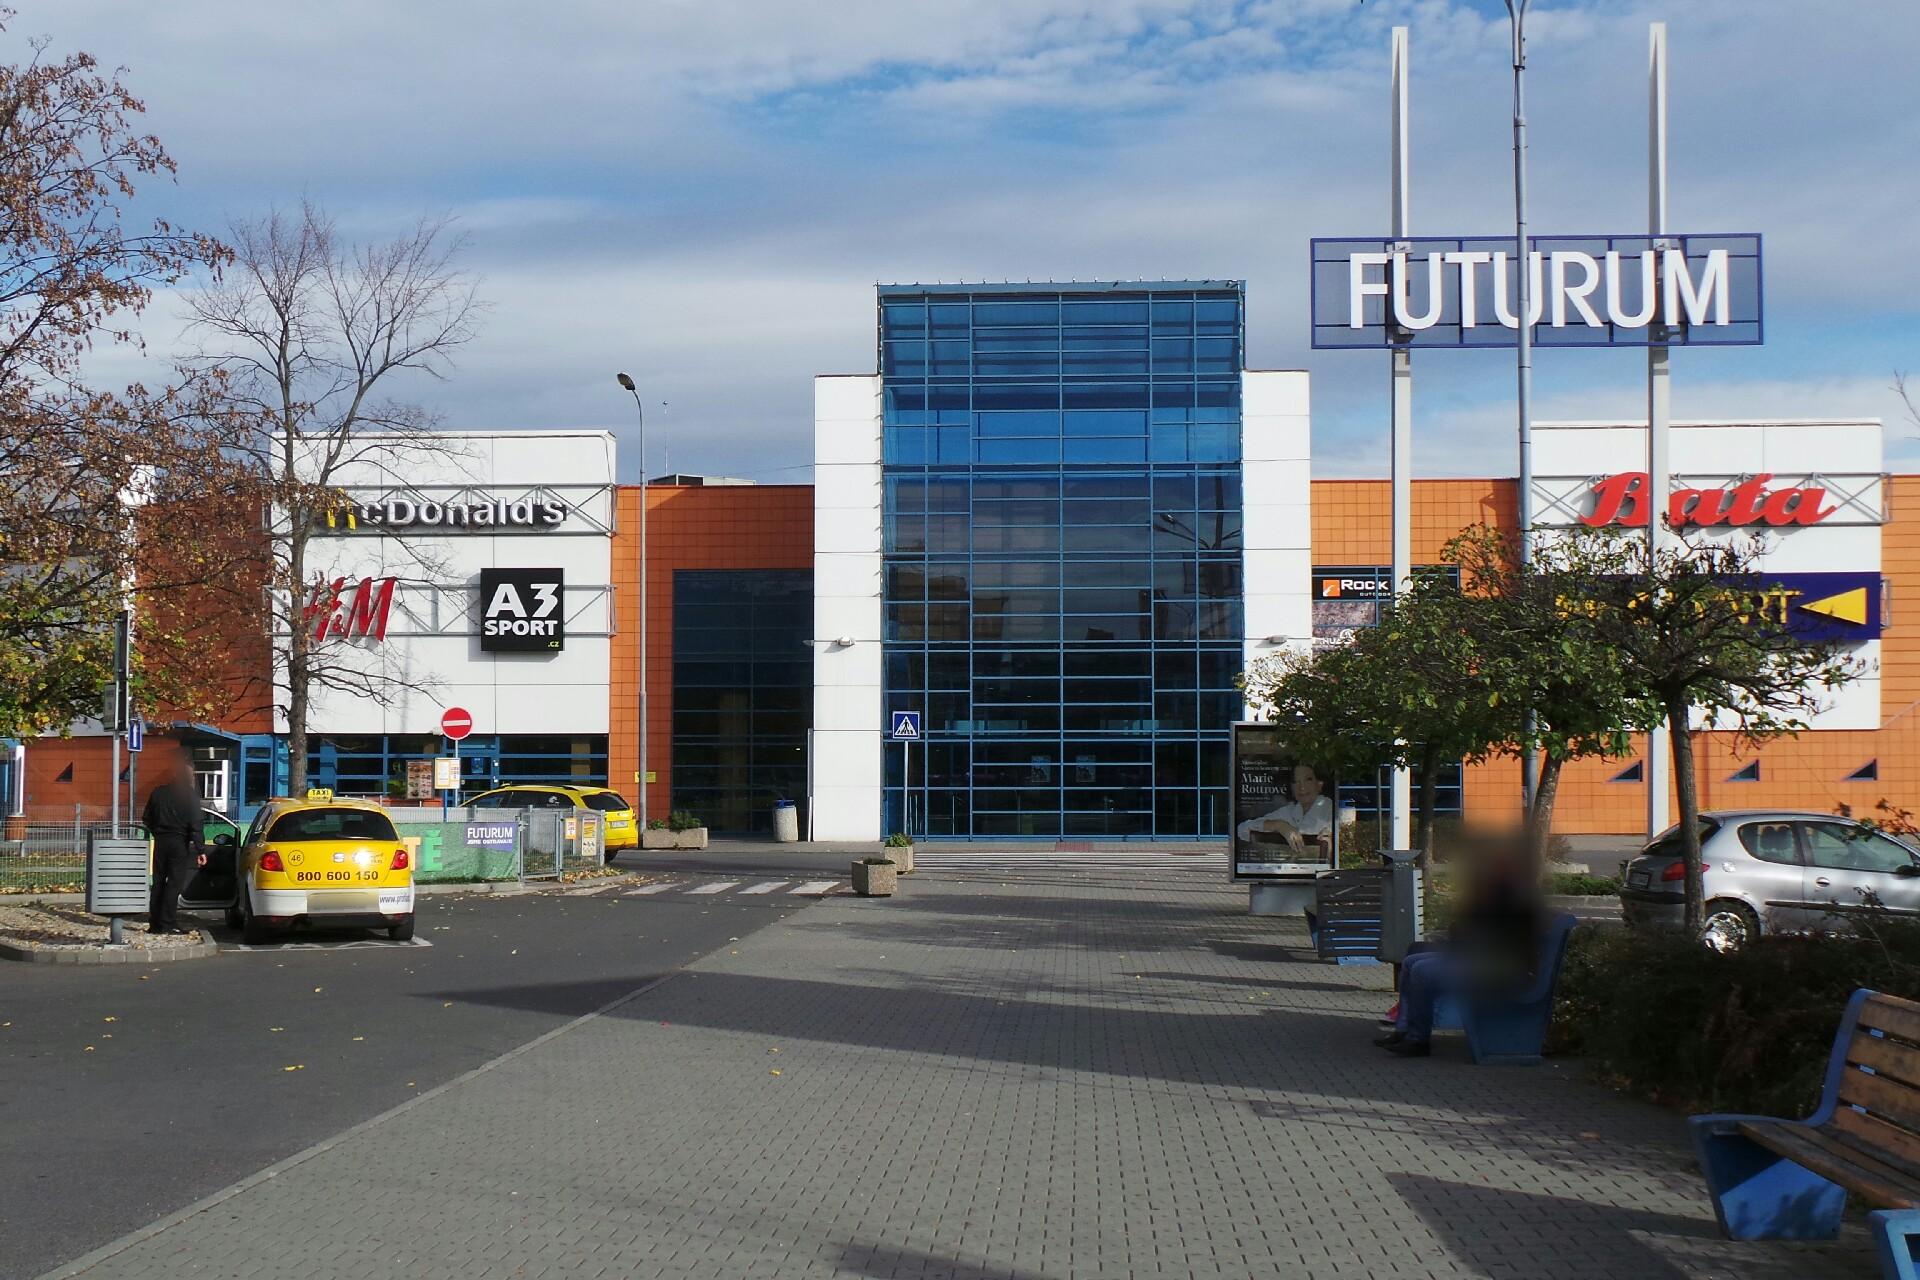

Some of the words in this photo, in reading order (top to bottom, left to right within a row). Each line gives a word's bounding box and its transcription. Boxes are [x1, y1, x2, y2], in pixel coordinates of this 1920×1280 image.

[1349, 249, 1729, 330] FUTURUM
[485, 583, 560, 618] A3
[484, 620, 559, 636] SPORT
[1241, 773, 1273, 783] Marie
[467, 827, 513, 839] FUTURUM
[297, 871, 322, 881] 800
[326, 871, 351, 881] 600
[355, 870, 379, 880] 150
